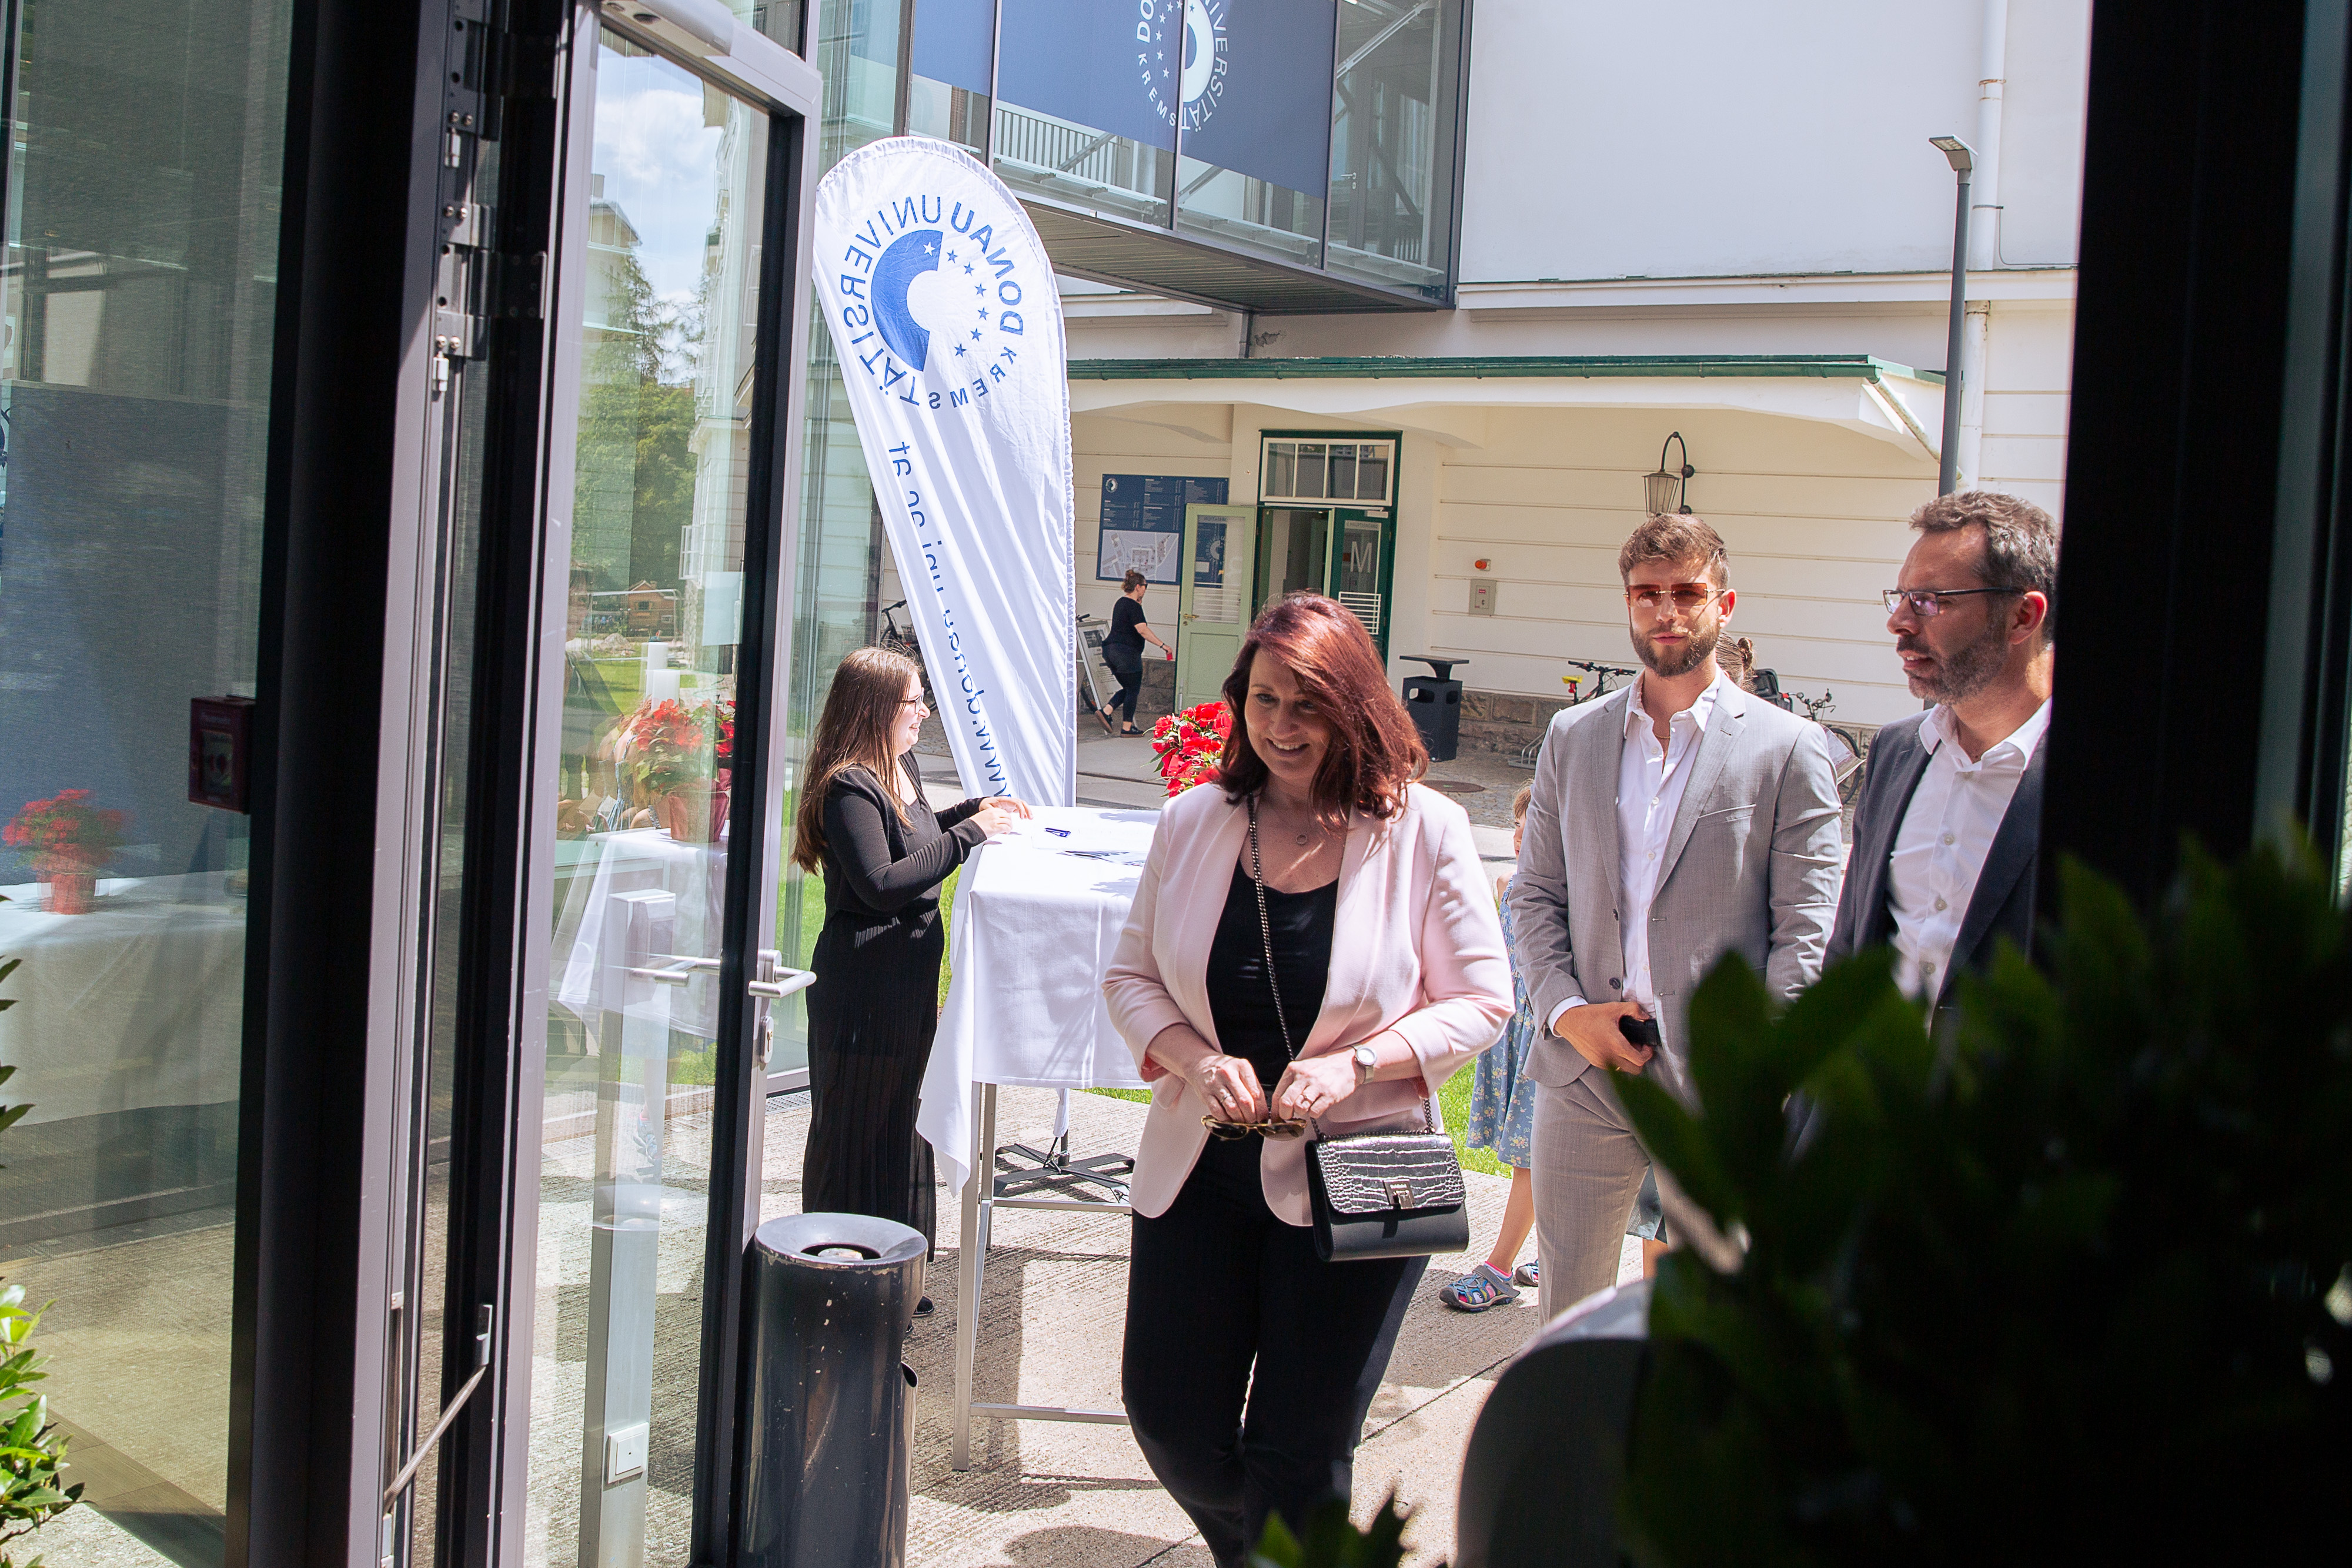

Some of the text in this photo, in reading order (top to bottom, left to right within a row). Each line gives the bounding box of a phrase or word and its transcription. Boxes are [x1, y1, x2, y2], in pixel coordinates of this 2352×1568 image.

[1138, 53, 1177, 127] KREMS
[1181, 0, 1228, 132] IVERSITÄT
[1350, 541, 1372, 573] M
